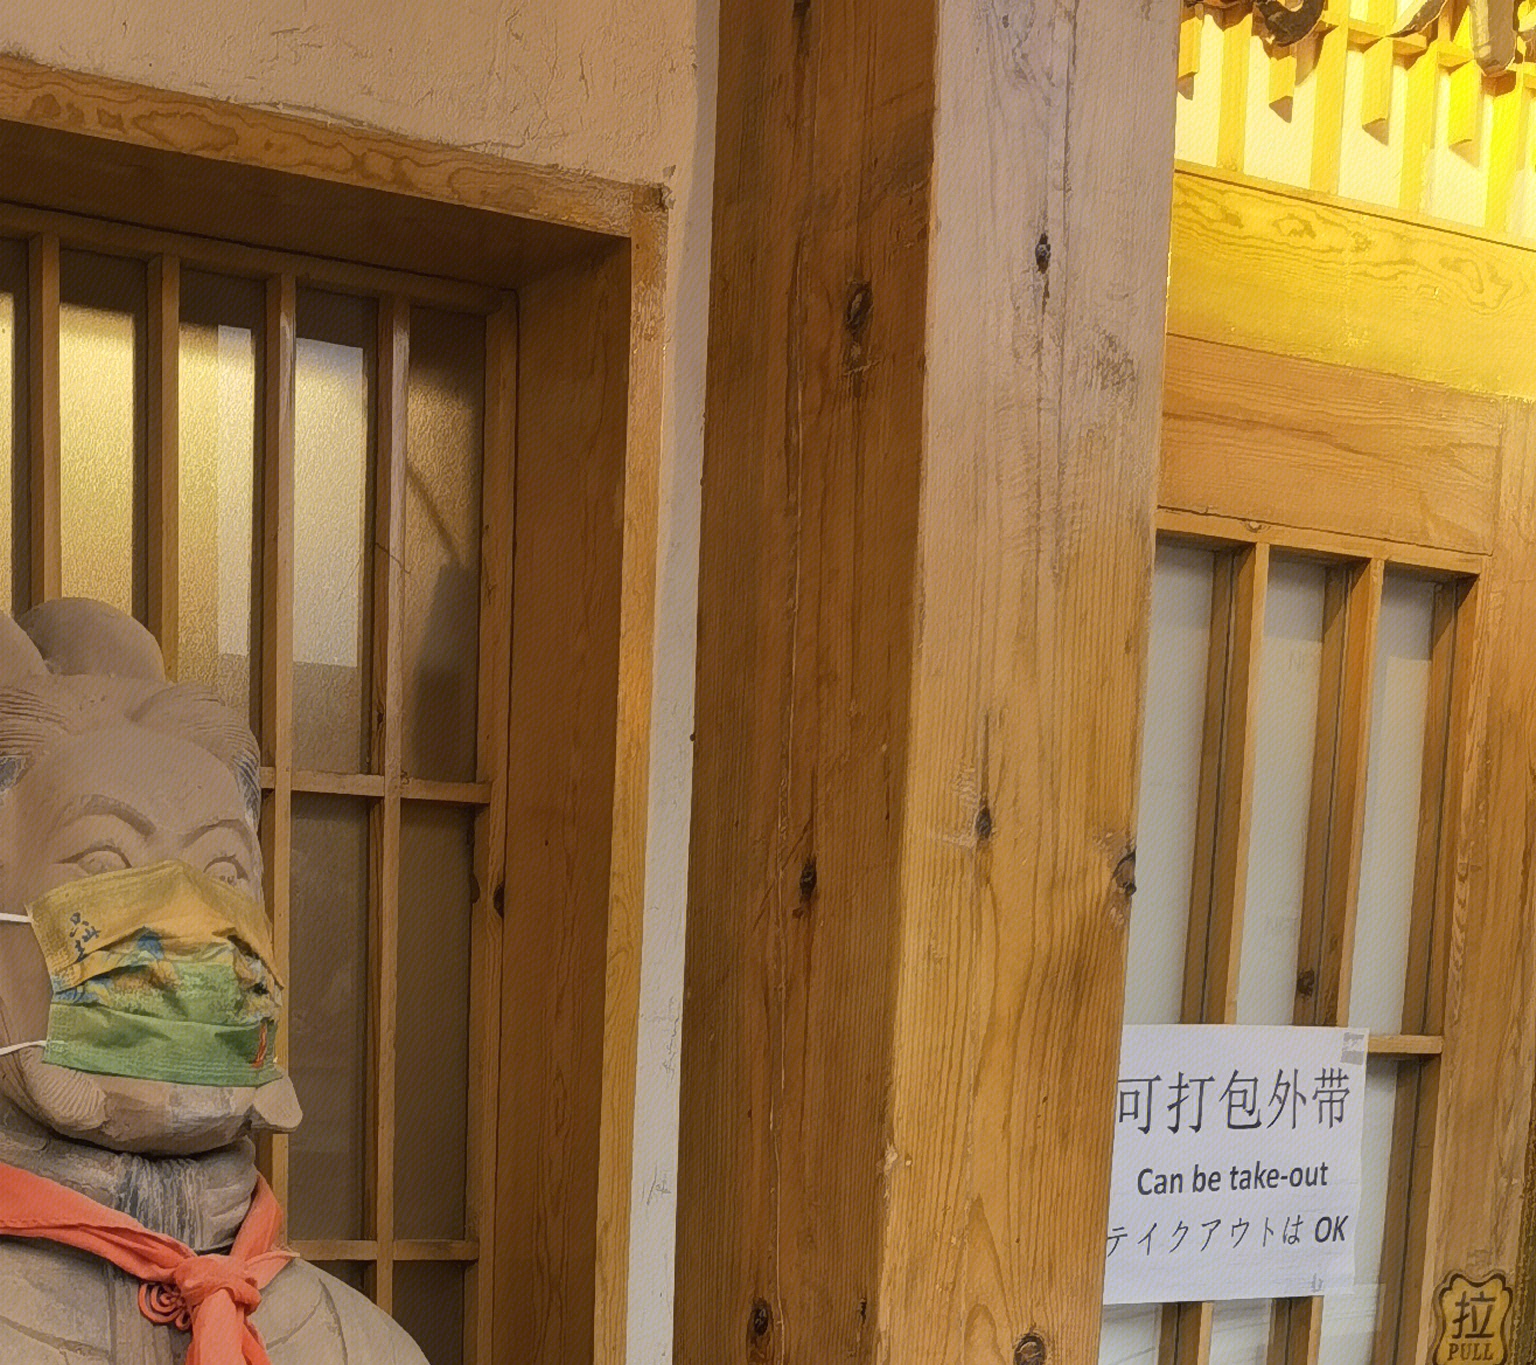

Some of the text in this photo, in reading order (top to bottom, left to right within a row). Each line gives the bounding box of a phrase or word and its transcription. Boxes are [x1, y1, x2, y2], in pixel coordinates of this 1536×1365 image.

[1117, 1067, 1350, 1134] 可打包外带
[1137, 1160, 1328, 1195] Can be take-out
[1314, 1215, 1349, 1243] OK
[1452, 1291, 1497, 1339] 拉
[1447, 1343, 1495, 1361] PULL
